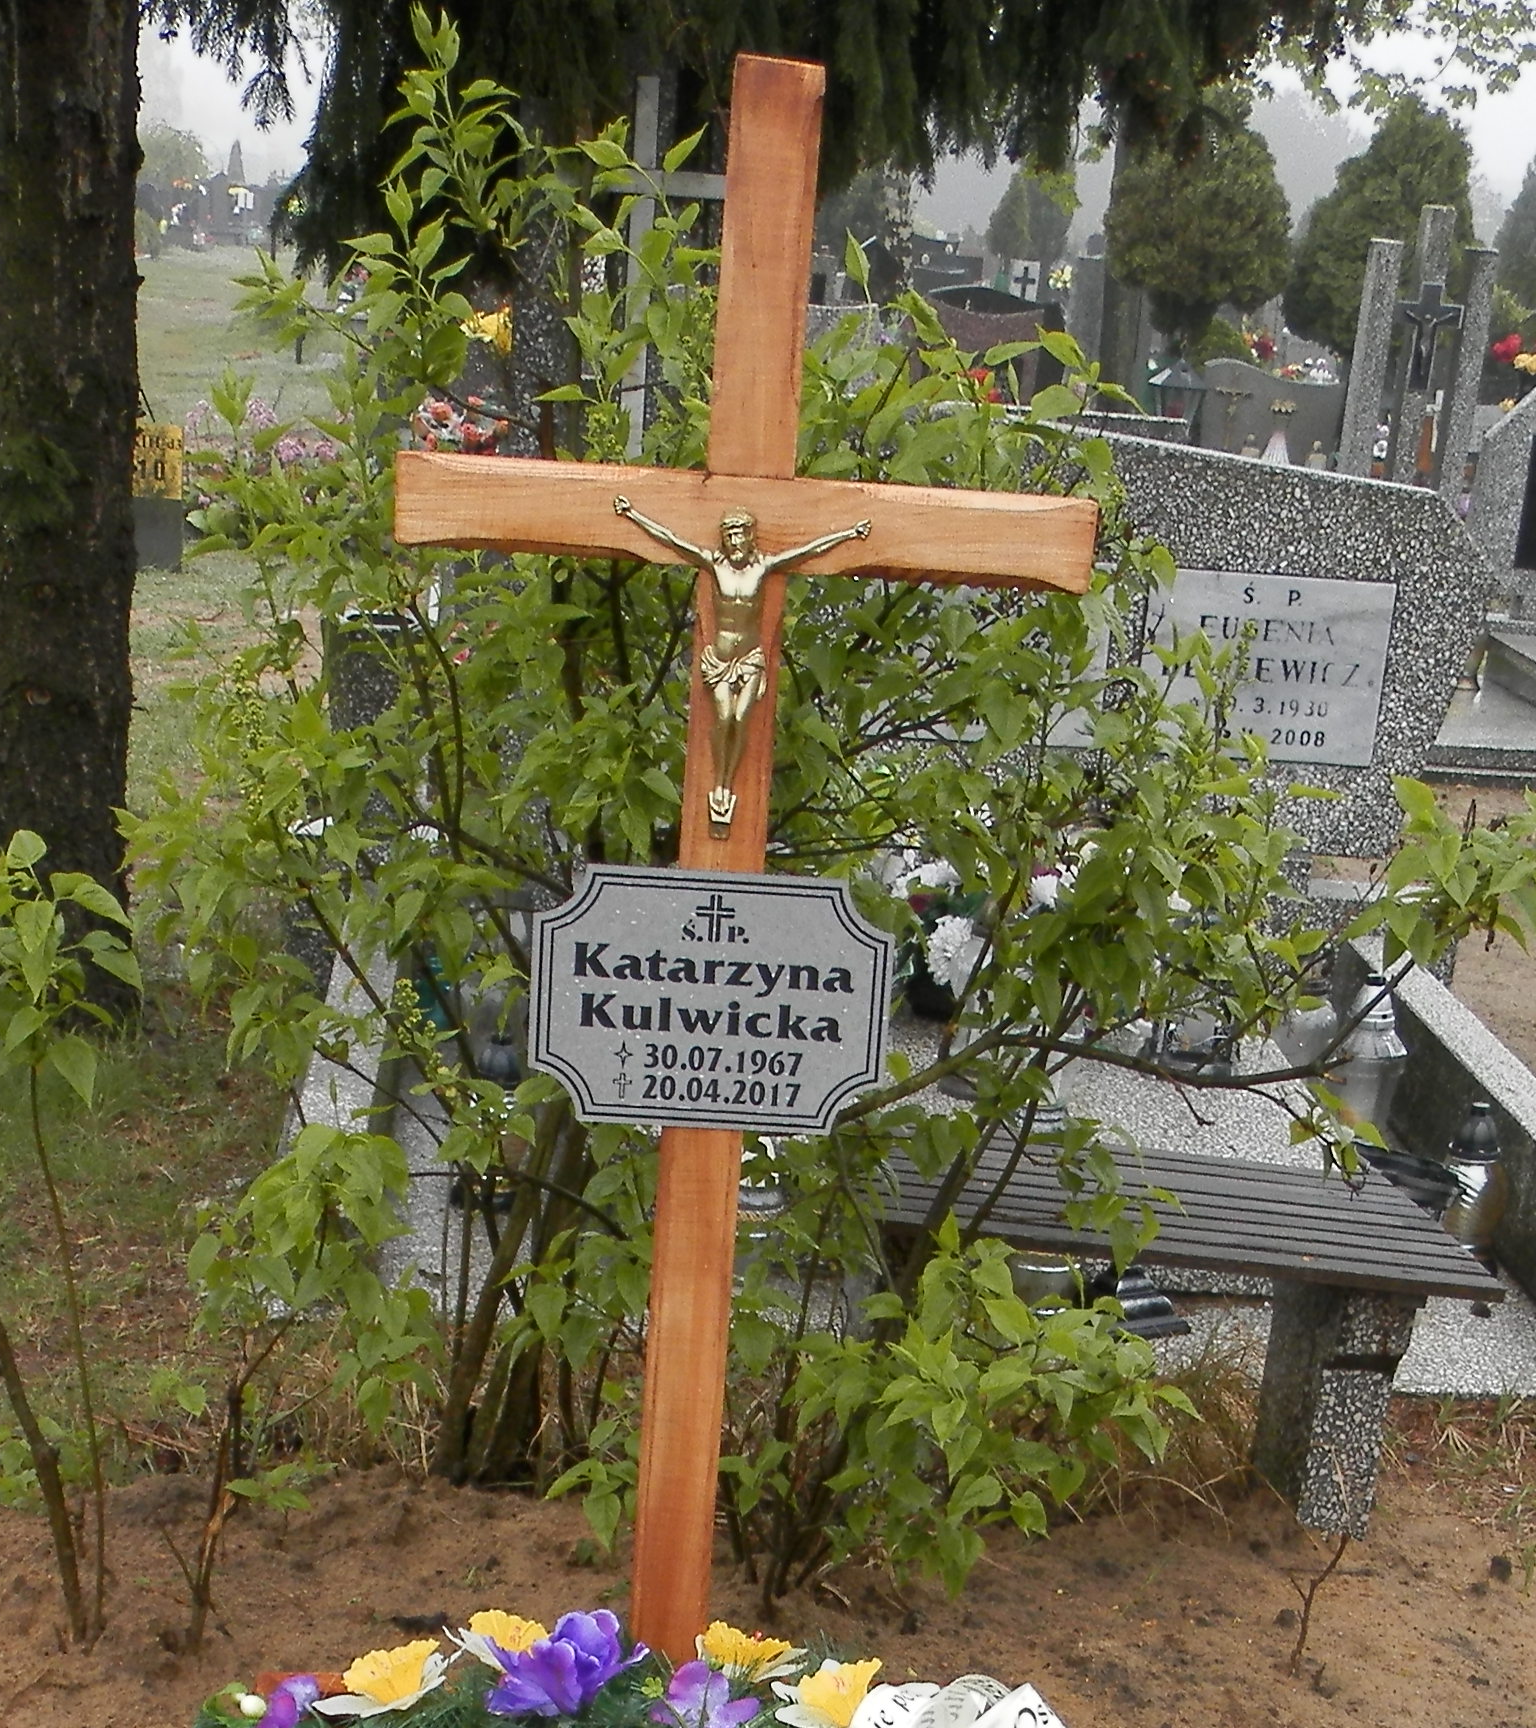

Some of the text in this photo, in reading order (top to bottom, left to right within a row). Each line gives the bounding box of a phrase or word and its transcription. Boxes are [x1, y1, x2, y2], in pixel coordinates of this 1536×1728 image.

[573, 942, 855, 998] Katarzyna
[579, 993, 843, 1044] Kulwicka
[644, 1043, 804, 1077] 30.07.1967
[642, 1074, 802, 1108] 20.04.2017
